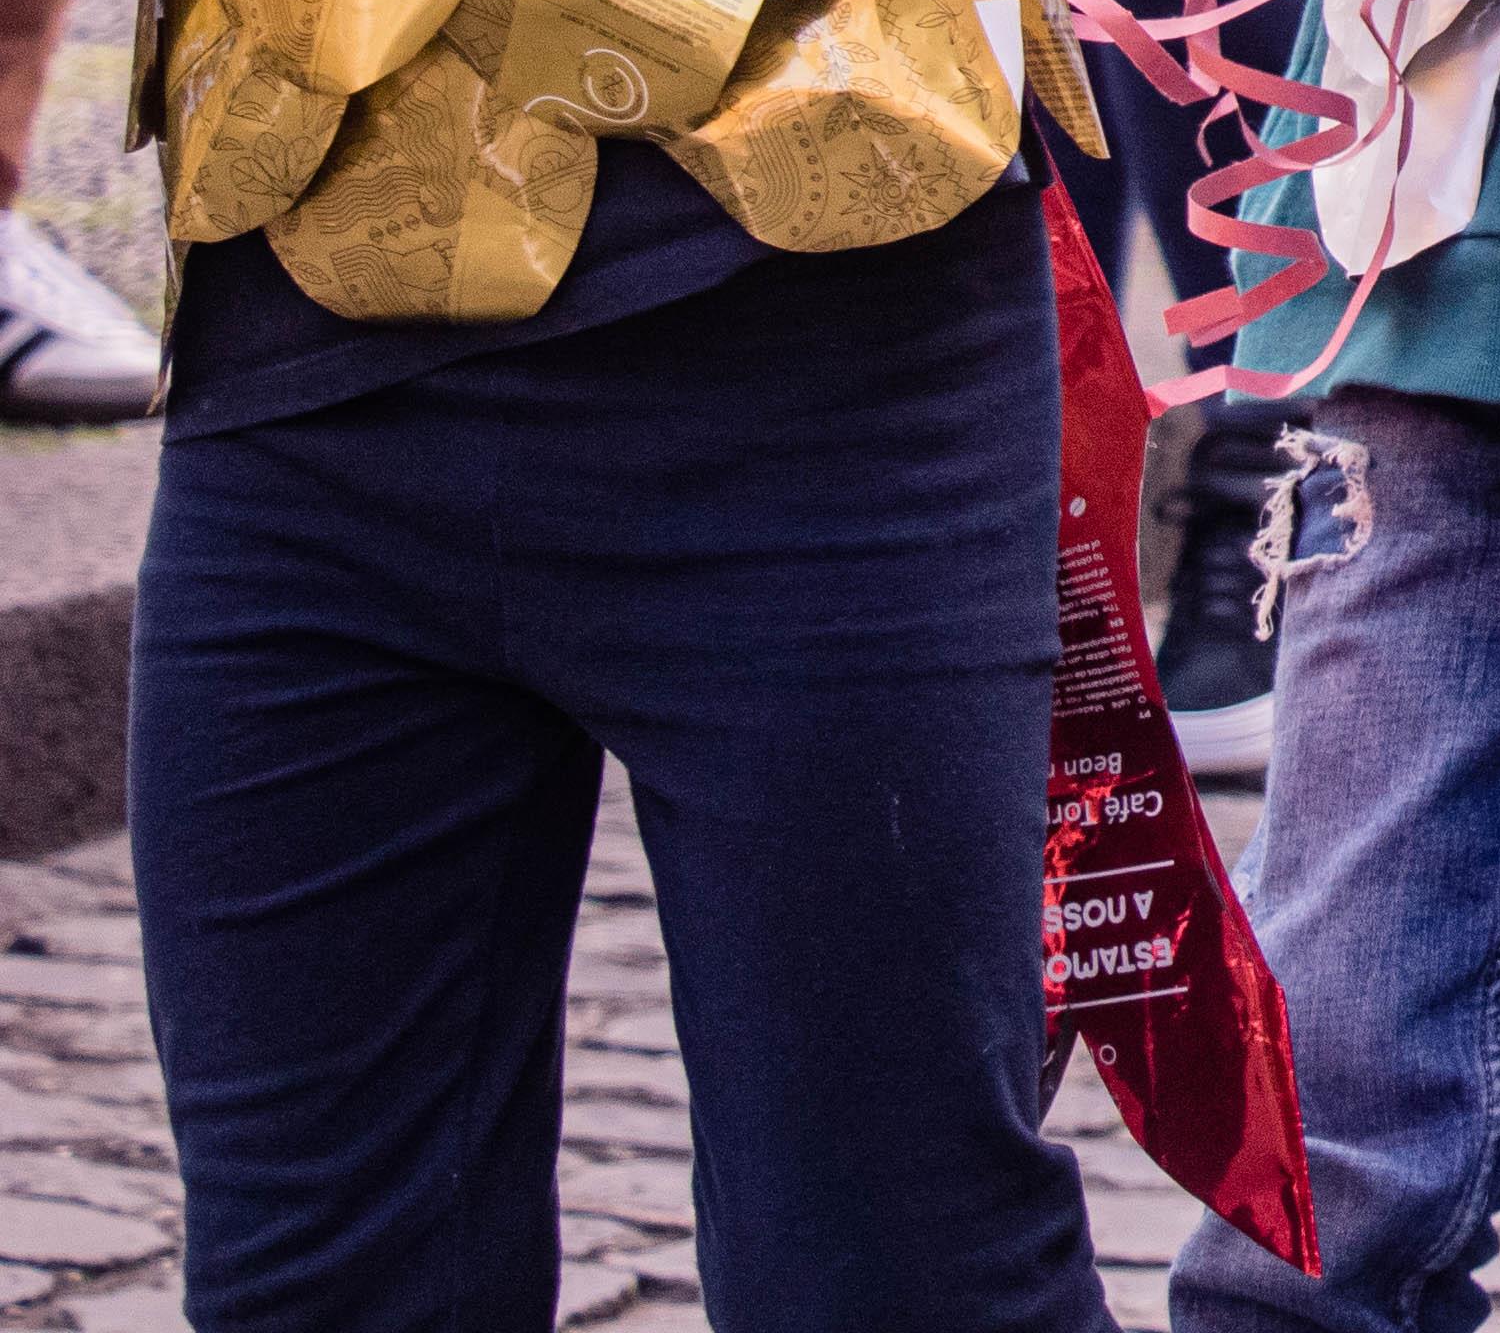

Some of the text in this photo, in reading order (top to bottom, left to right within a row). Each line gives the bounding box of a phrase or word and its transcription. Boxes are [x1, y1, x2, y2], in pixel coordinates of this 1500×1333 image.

[1063, 751, 1122, 779] Bean
[1105, 789, 1164, 824] Café
[1132, 889, 1153, 920] A
[1043, 936, 1174, 983] ESTAMO
